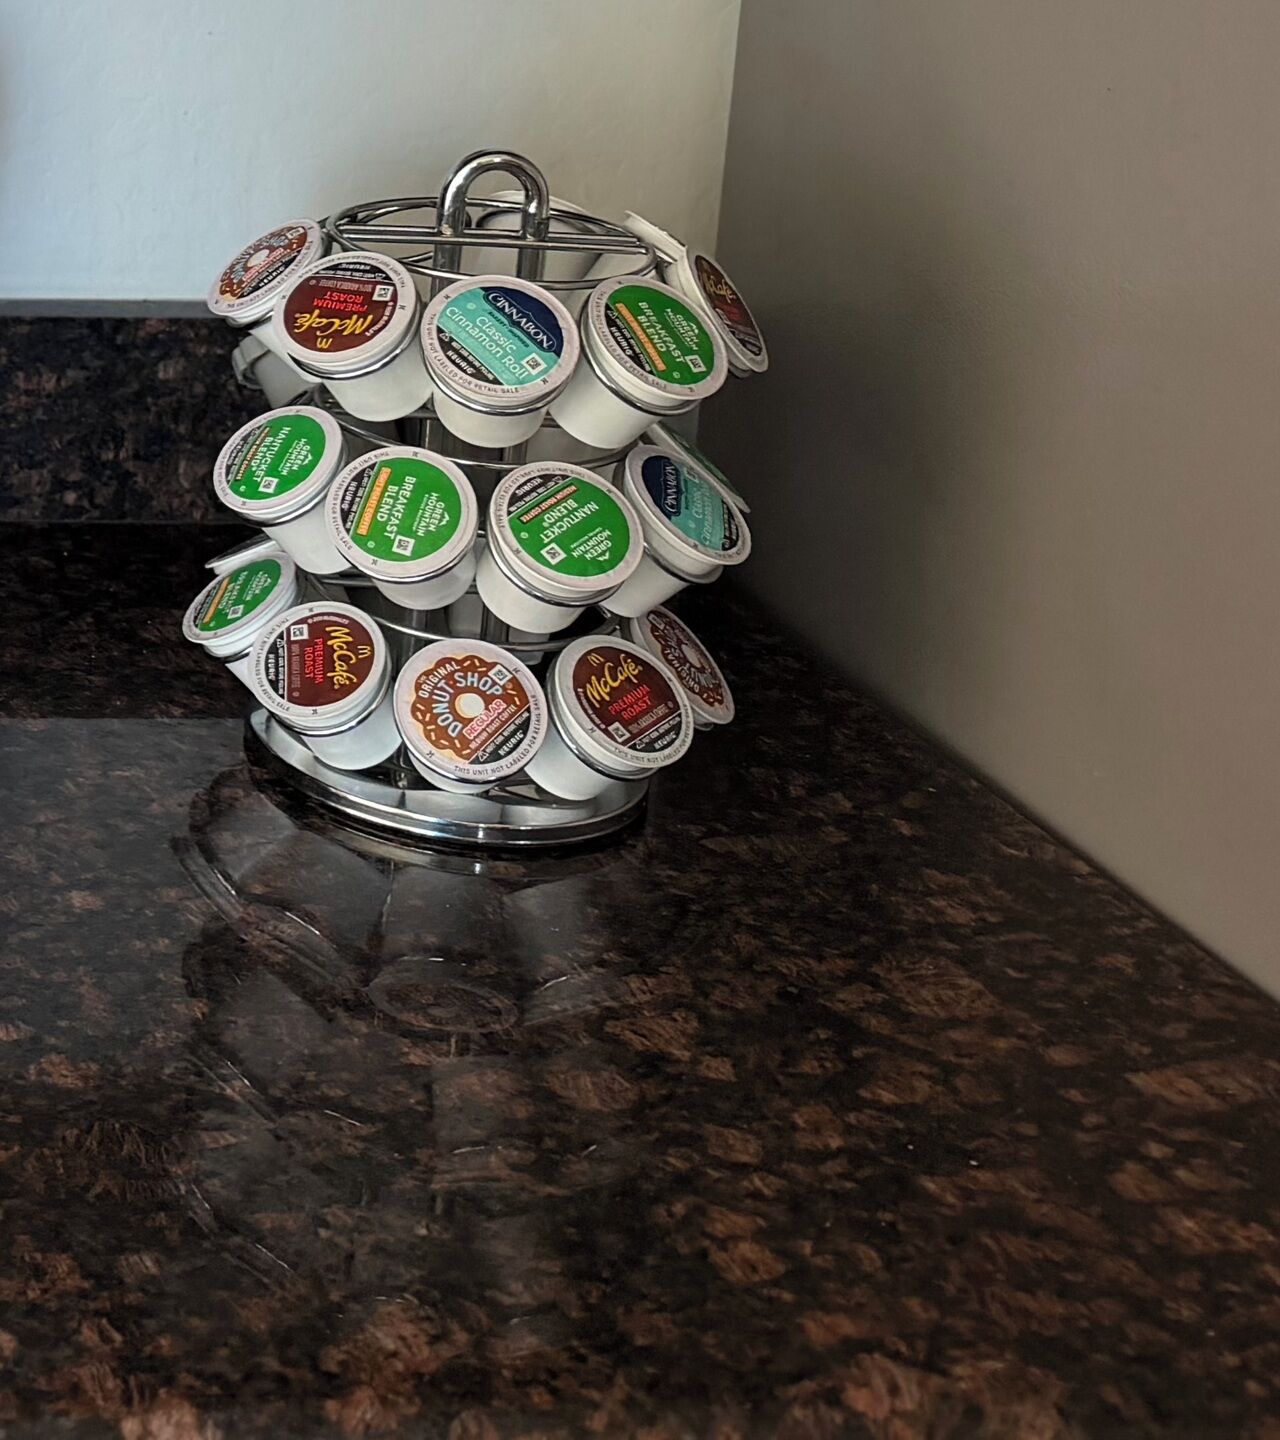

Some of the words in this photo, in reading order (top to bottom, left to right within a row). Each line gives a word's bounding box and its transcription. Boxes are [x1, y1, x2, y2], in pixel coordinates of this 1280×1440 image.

[313, 298, 368, 312] PREMIUM
[324, 291, 363, 303] ROAST
[294, 309, 373, 335] McCafé
[476, 316, 517, 354] Classic
[488, 293, 553, 349] CINNABON
[637, 315, 667, 351] BLEND
[639, 302, 686, 363] BREAKFAST
[676, 314, 699, 343] GREEN
[446, 307, 503, 357] Cinnamon
[502, 355, 529, 379] Roll
[609, 325, 633, 356] KEURIG
[433, 353, 459, 379] LABELED
[445, 348, 475, 375] KEURIG
[253, 427, 292, 482] NANTUCKET
[281, 438, 308, 476] MOUNTAIN
[291, 445, 311, 470] GREEN
[340, 479, 358, 511] KEURIG
[514, 475, 543, 496] KEURIG
[376, 485, 399, 522] BLEND
[383, 476, 416, 540] BREAKFAST
[416, 492, 439, 537] MOUNTAIN
[427, 502, 445, 531] GREEN
[543, 498, 578, 523] BLEND
[539, 501, 599, 544] NANTUCKET
[570, 529, 612, 558] MOUNTAIN
[584, 540, 612, 560] GREEN
[267, 653, 275, 680] KEURIG
[304, 647, 314, 679] ROAST
[314, 638, 324, 683] PREMIUM
[325, 626, 358, 686] McCafé
[418, 661, 461, 698] ORIGINAL
[586, 653, 639, 708] McCafé
[432, 680, 463, 737] DONUT
[454, 672, 504, 696] SHOP
[608, 684, 651, 714] PREMIUM
[621, 696, 652, 720] ROAST
[465, 700, 507, 738] REGULAR
[454, 765, 470, 774] THIS
[473, 768, 489, 776] UNIT
[491, 766, 504, 774] NOT
[505, 747, 530, 769] LABELED
[528, 734, 537, 748] FOR
[496, 729, 525, 756] KEURIG
